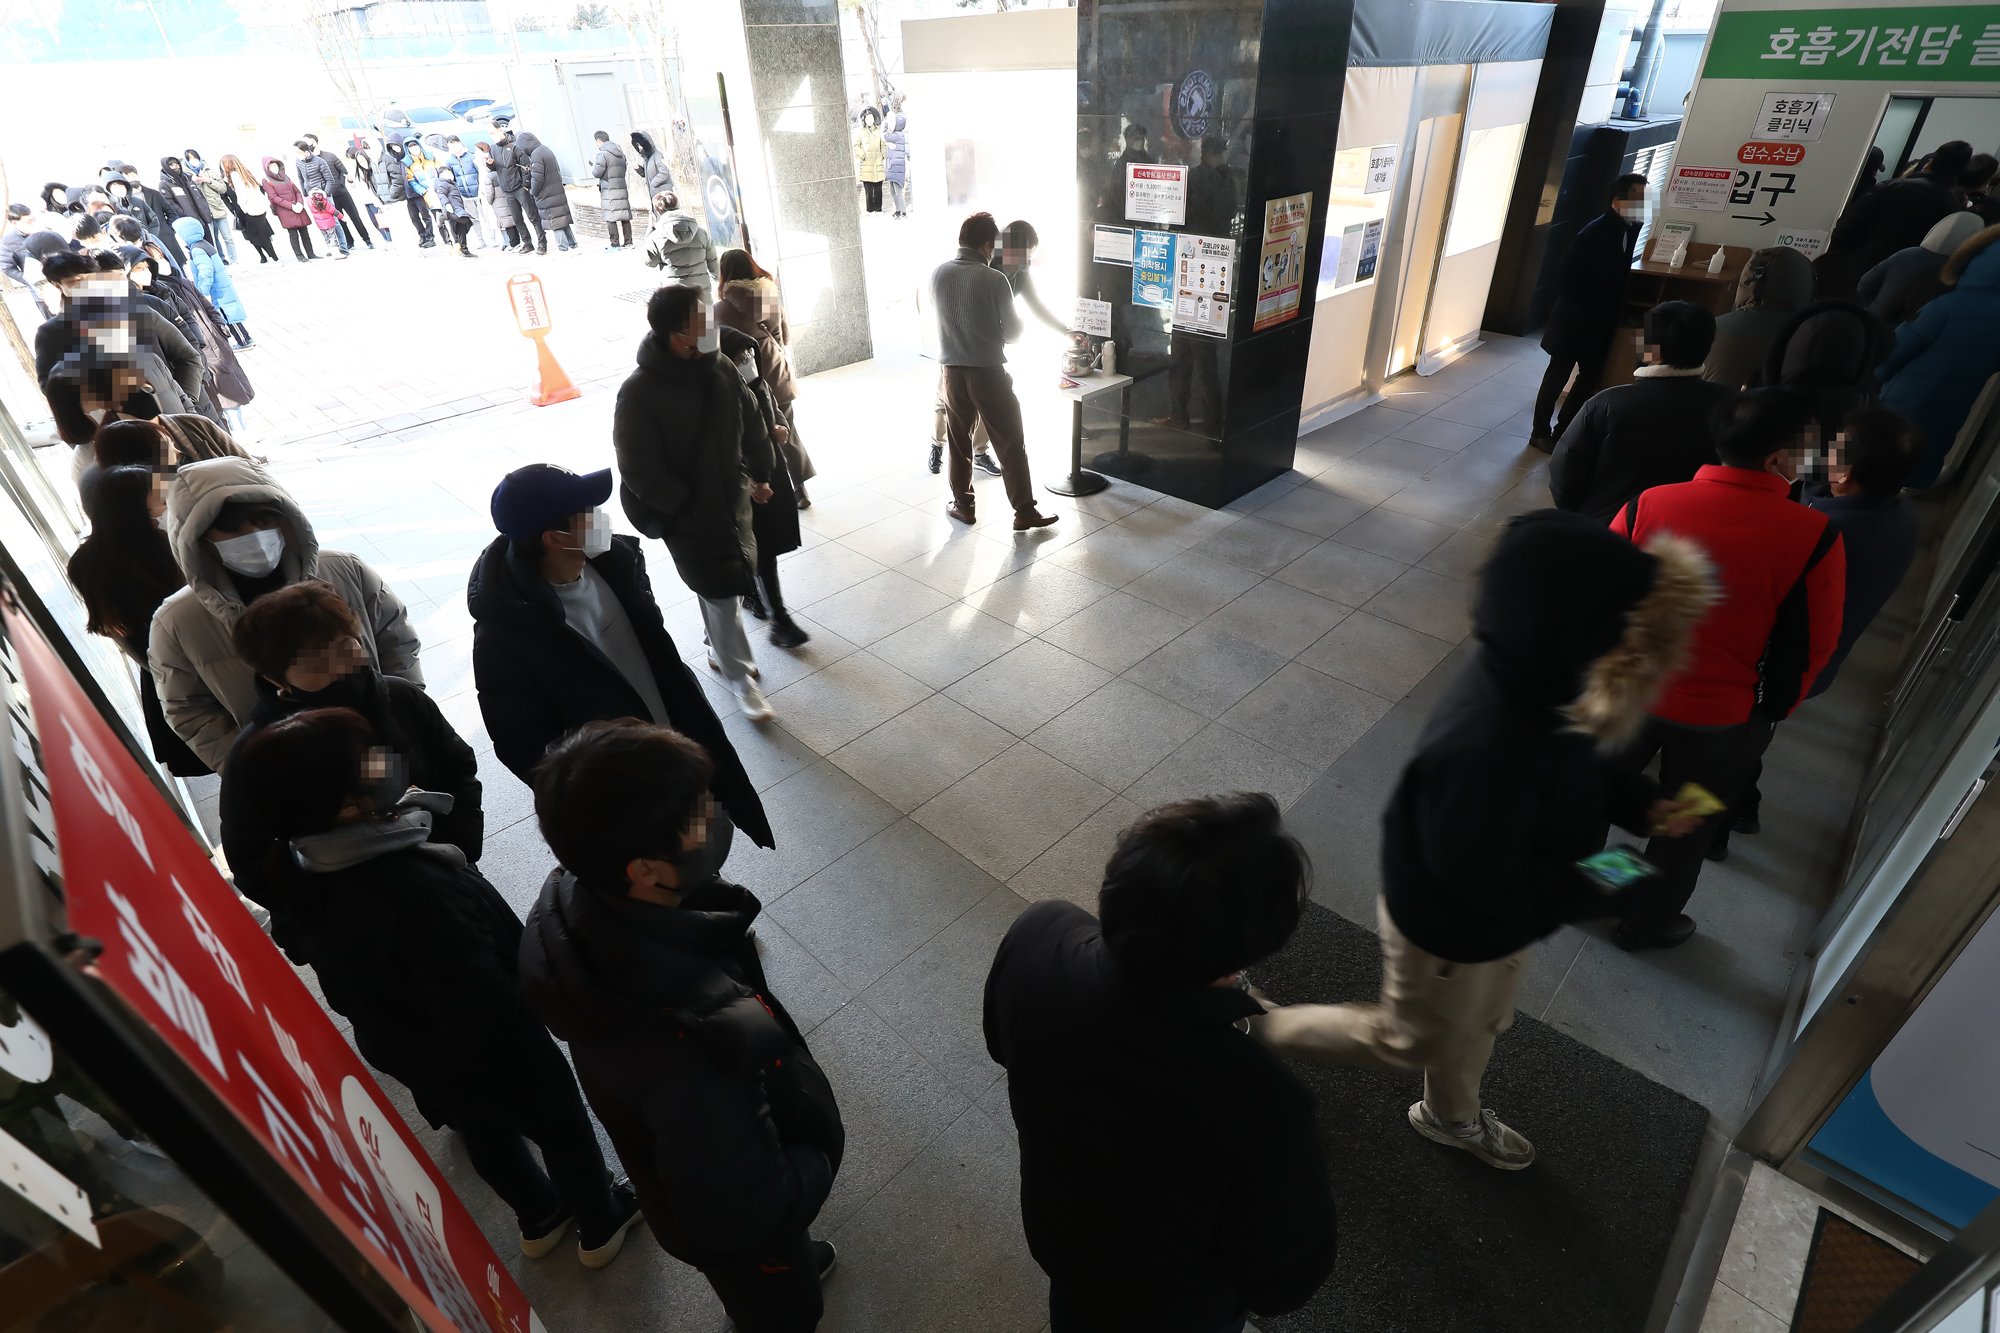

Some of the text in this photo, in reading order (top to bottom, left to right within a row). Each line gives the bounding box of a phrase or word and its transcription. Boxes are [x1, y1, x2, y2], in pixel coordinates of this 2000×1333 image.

[1760, 25, 1963, 66] 호흡기전담
[1772, 100, 1819, 115] 호흡기
[1767, 117, 1812, 133] 클리닉
[1742, 145, 1801, 162] 접수,수납
[1729, 171, 1796, 207] 입구
[1142, 245, 1168, 259] 마스크
[1141, 260, 1167, 271] 미착용시
[1140, 271, 1167, 283] 출입불가
[521, 285, 541, 327] 주차금지
